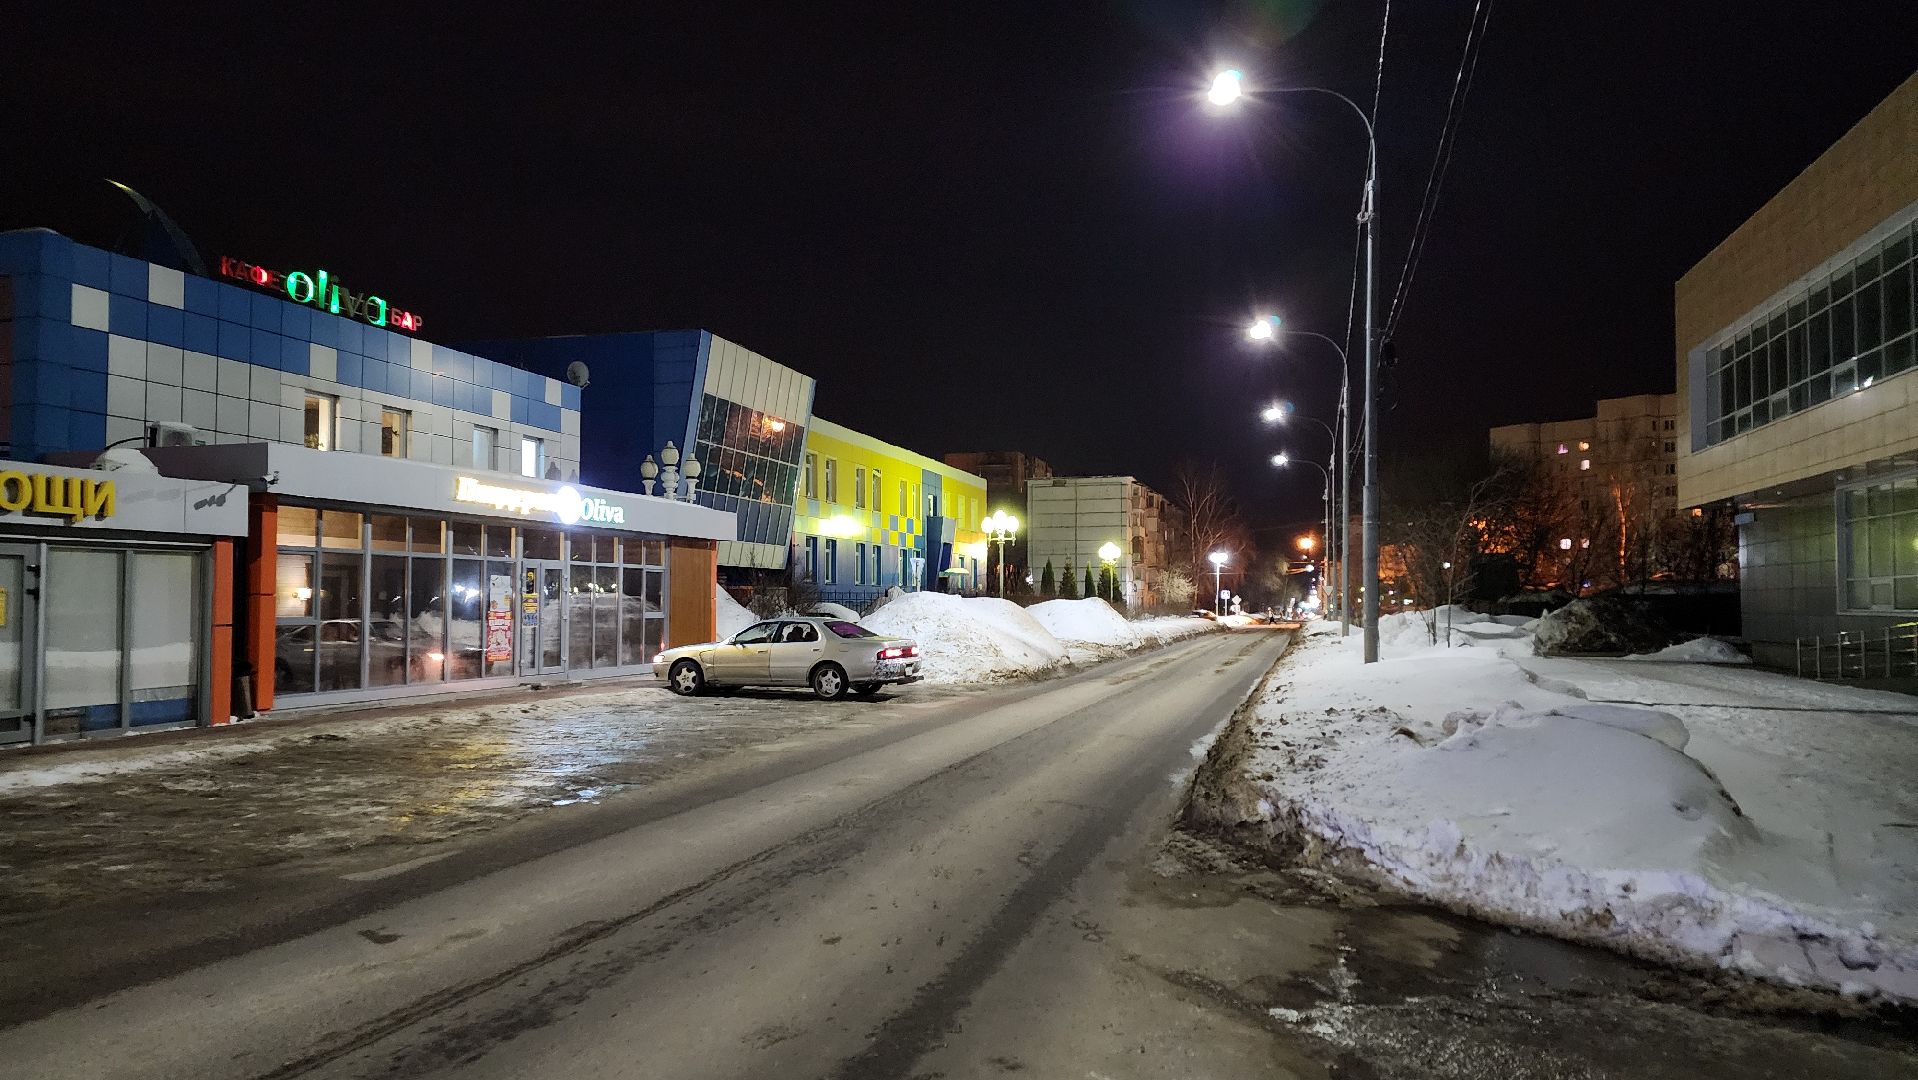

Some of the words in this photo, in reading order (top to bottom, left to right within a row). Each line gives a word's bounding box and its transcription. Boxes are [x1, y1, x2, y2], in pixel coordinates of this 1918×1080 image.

[220, 255, 281, 289] КАФЕ
[286, 269, 387, 327] oliva
[391, 307, 423, 331] БАР
[581, 497, 625, 524] Oliva
